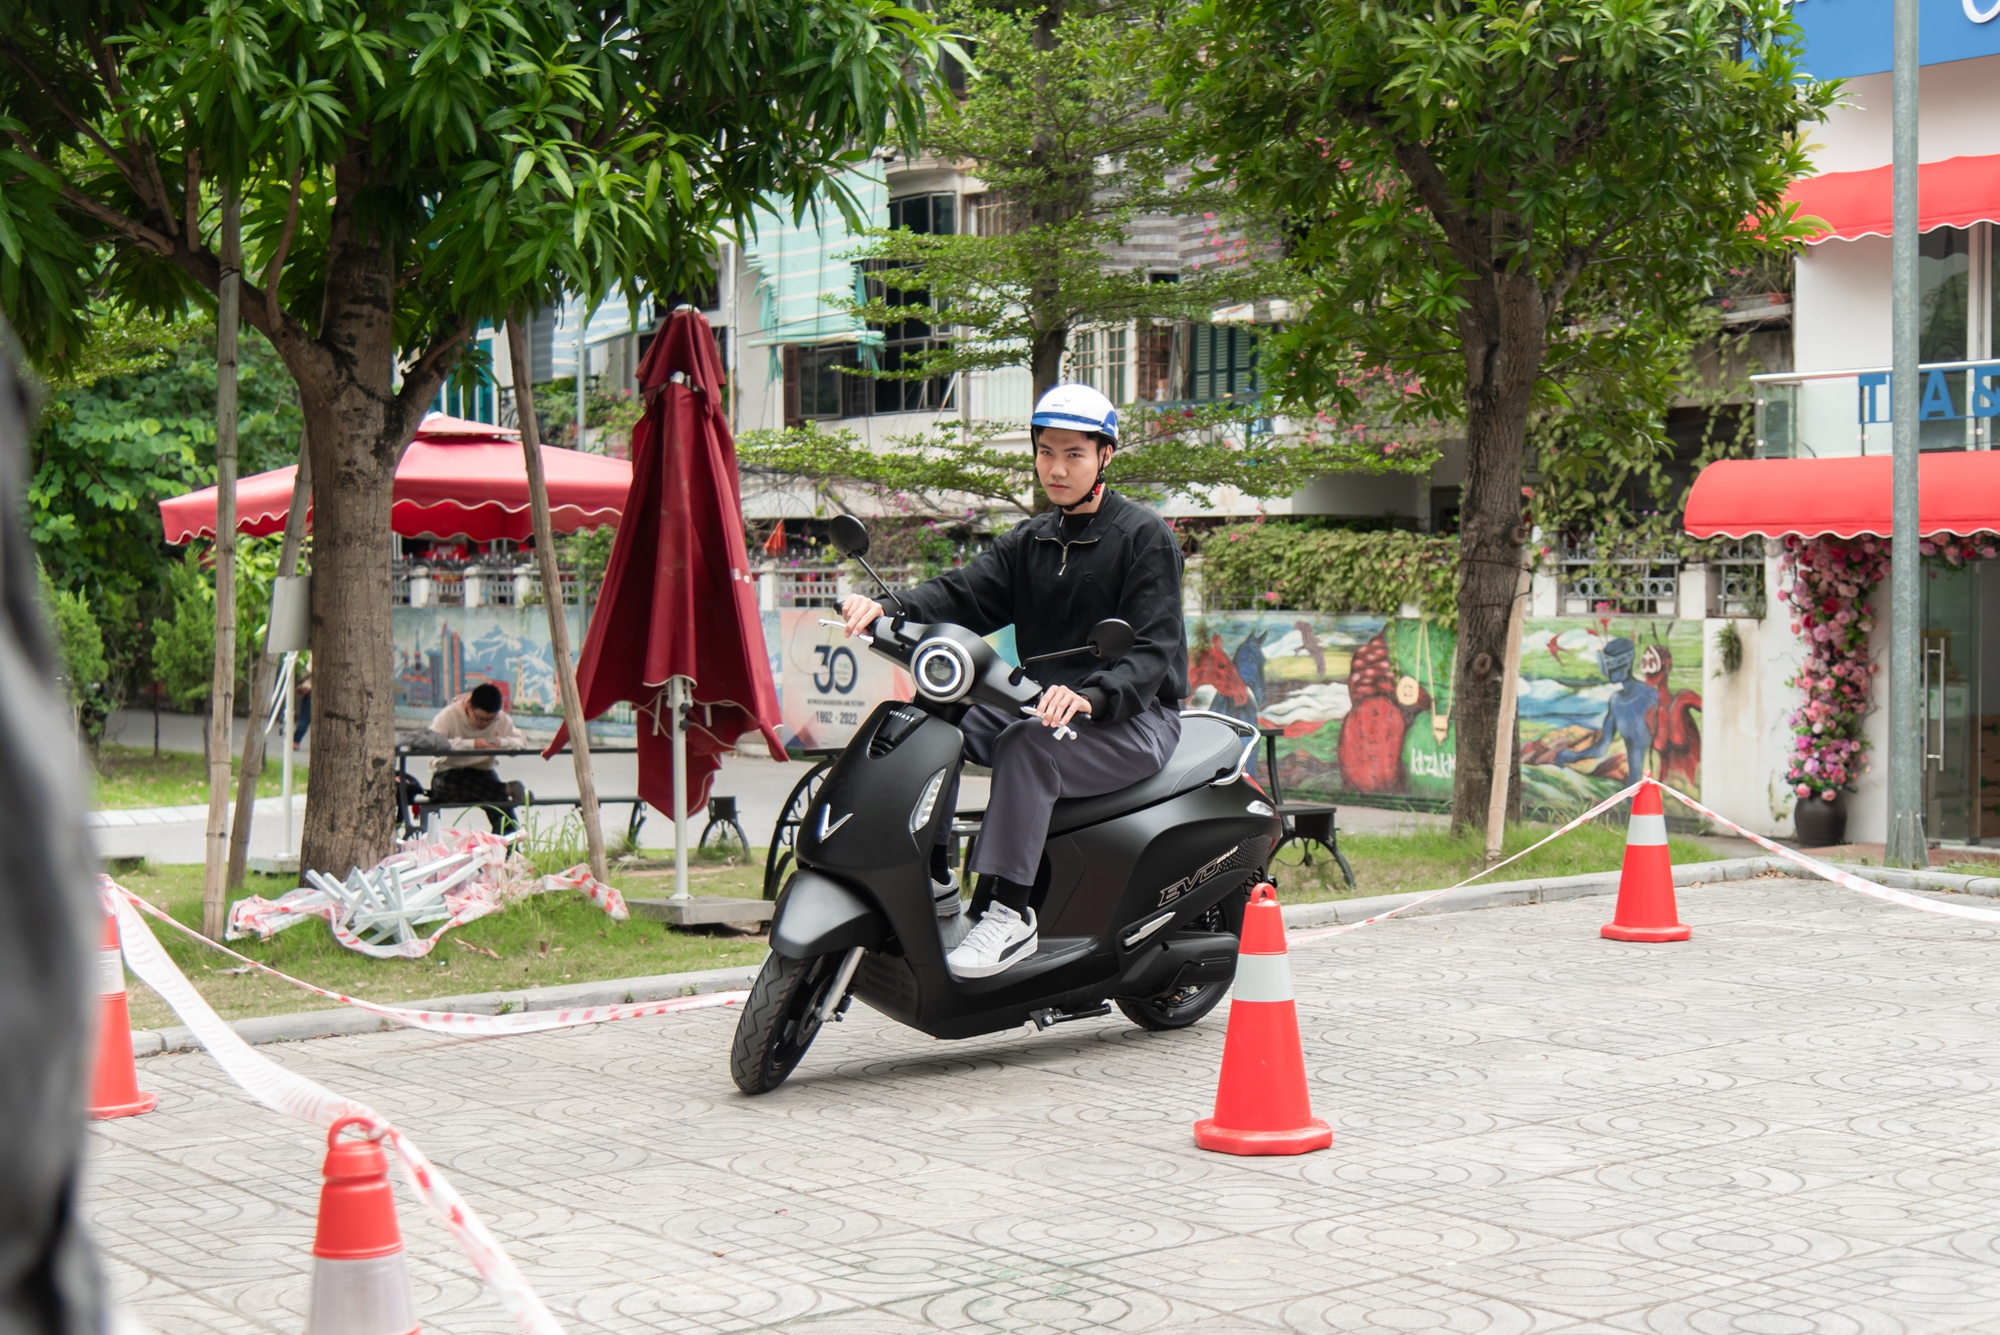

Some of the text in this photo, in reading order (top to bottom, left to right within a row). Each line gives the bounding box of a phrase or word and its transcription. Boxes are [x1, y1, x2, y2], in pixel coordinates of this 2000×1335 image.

[1859, 369, 1955, 423] TA
[814, 645, 858, 695] 30
[816, 711, 833, 724] 1992
[840, 712, 858, 725] 2022
